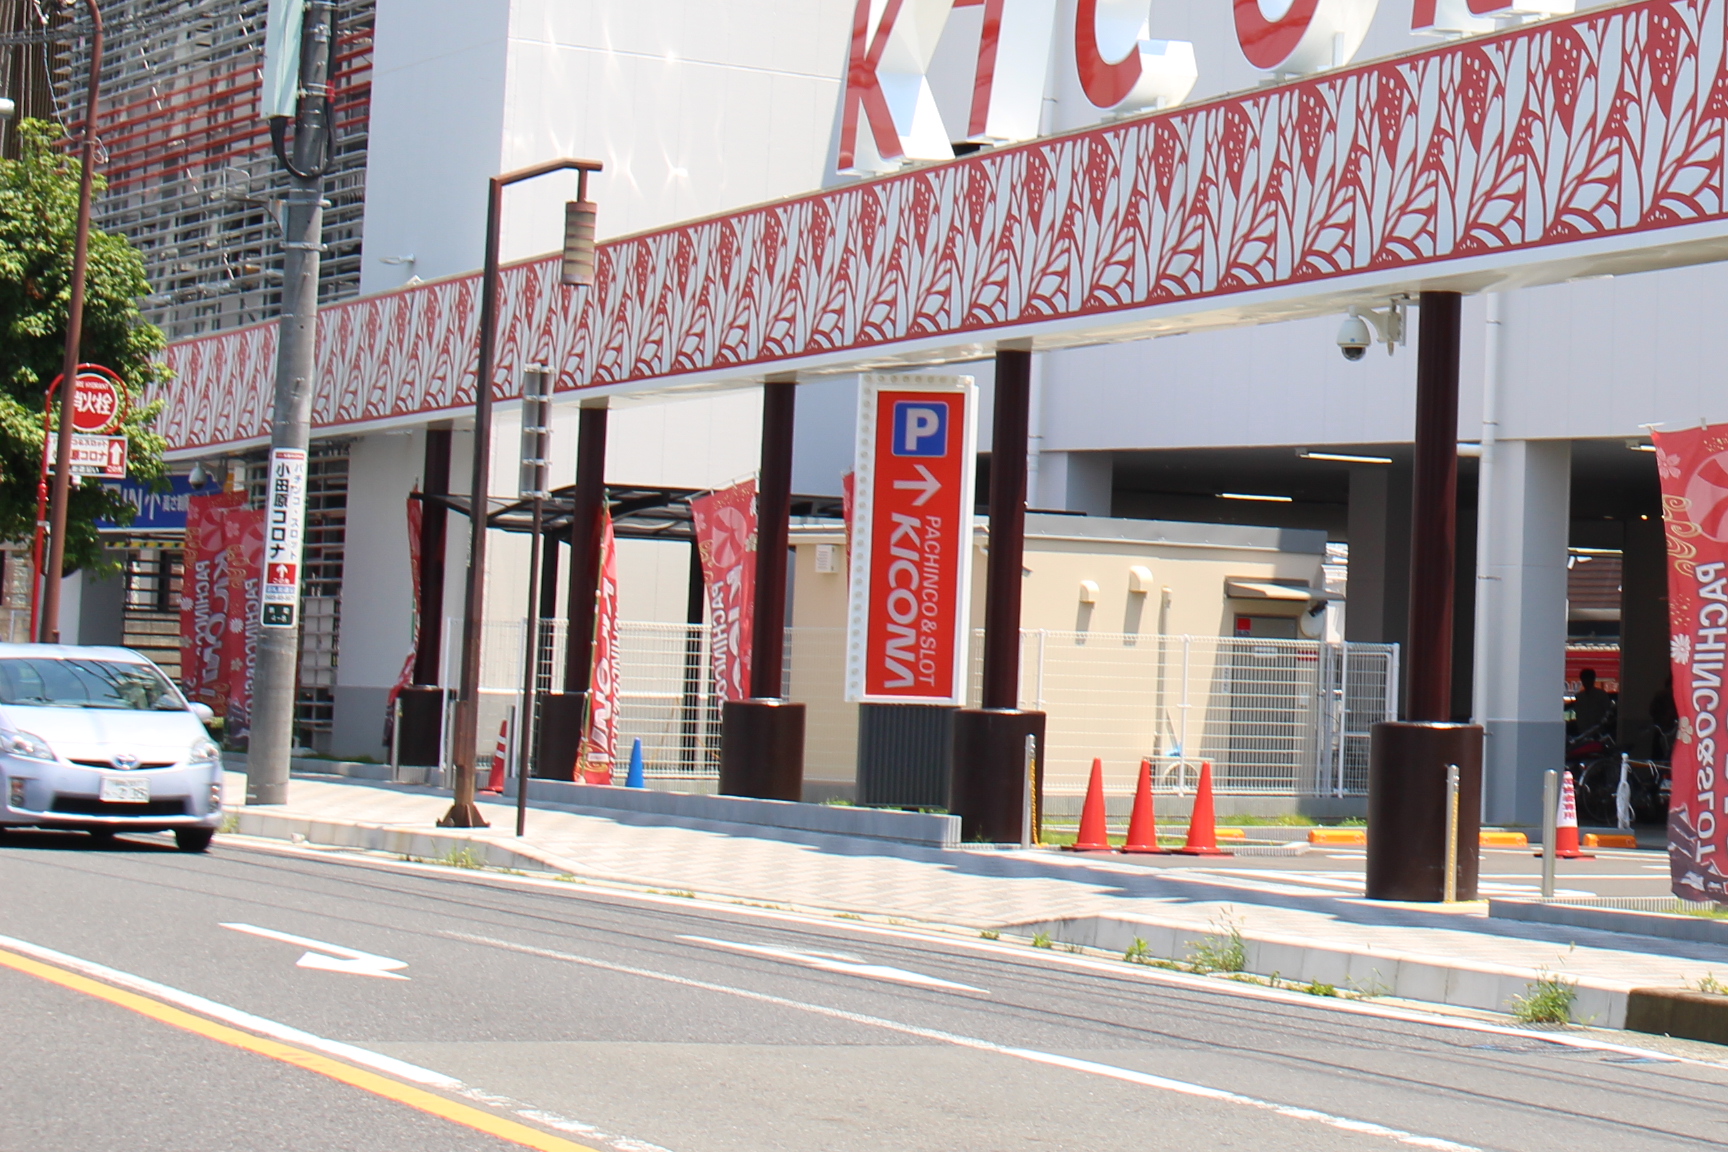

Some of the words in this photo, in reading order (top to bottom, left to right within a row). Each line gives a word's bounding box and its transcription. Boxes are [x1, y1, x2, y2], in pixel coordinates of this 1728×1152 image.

[74, 391, 113, 415] 消火栓
[905, 408, 940, 451] P
[270, 462, 290, 559] 小田原コロナ
[884, 512, 922, 689] KICONA
[921, 515, 942, 617] PACHINCO
[919, 635, 937, 687] SLOT
